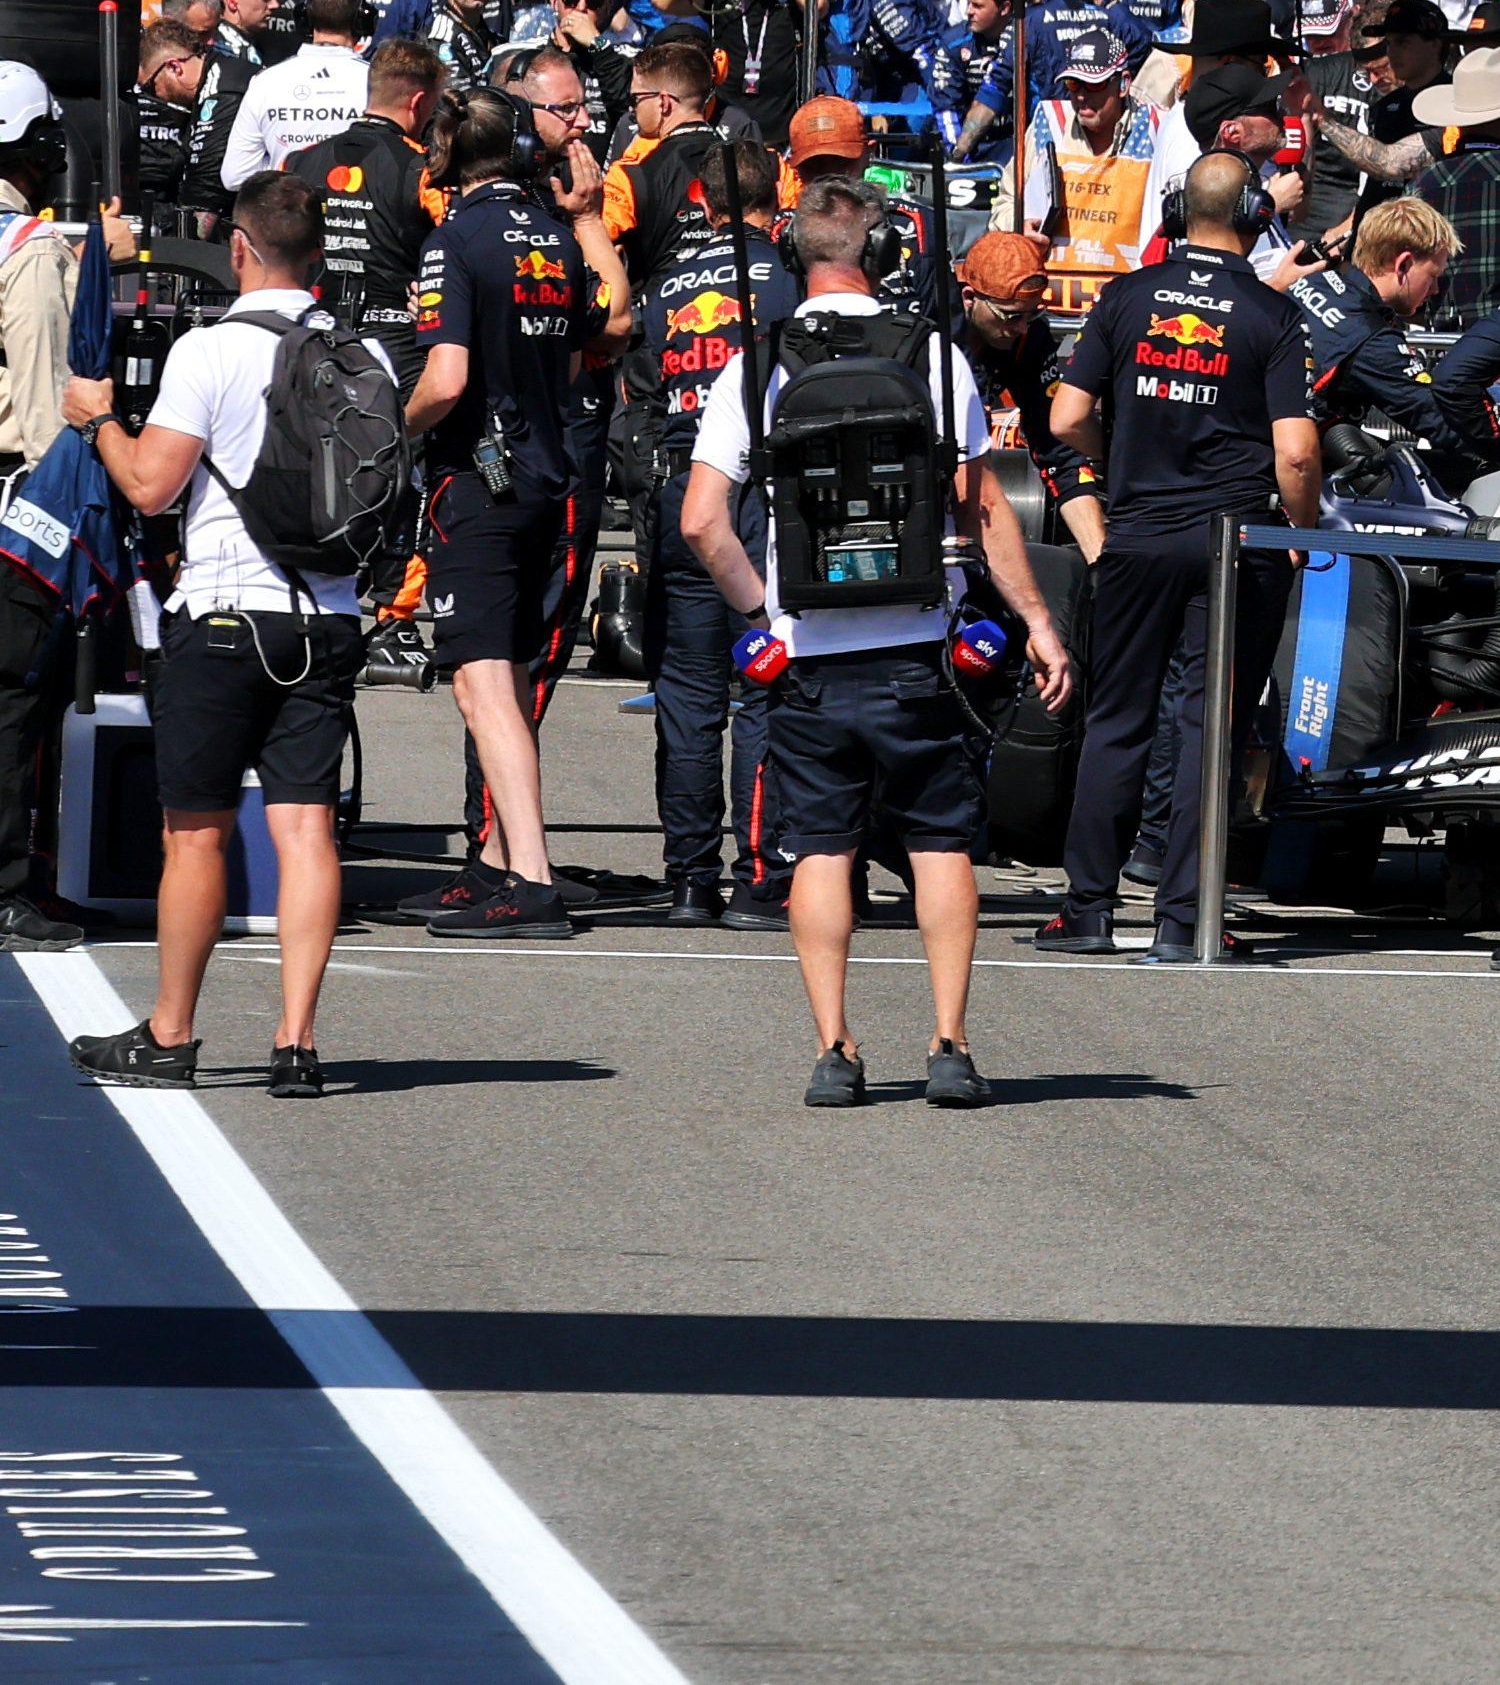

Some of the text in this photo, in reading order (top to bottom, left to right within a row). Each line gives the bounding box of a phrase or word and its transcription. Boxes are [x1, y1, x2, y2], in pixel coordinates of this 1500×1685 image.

[1186, 251, 1224, 265] HONDA
[1153, 288, 1234, 313] ORACLE
[1286, 278, 1347, 329] RACLE
[1135, 340, 1231, 378] Red Bull
[1136, 375, 1194, 404] Mobil
[746, 635, 769, 656] sky
[754, 644, 784, 673] sports
[959, 646, 991, 673] sports
[975, 638, 998, 659] sky
[1294, 675, 1316, 734] Front
[1308, 682, 1330, 738] Right
